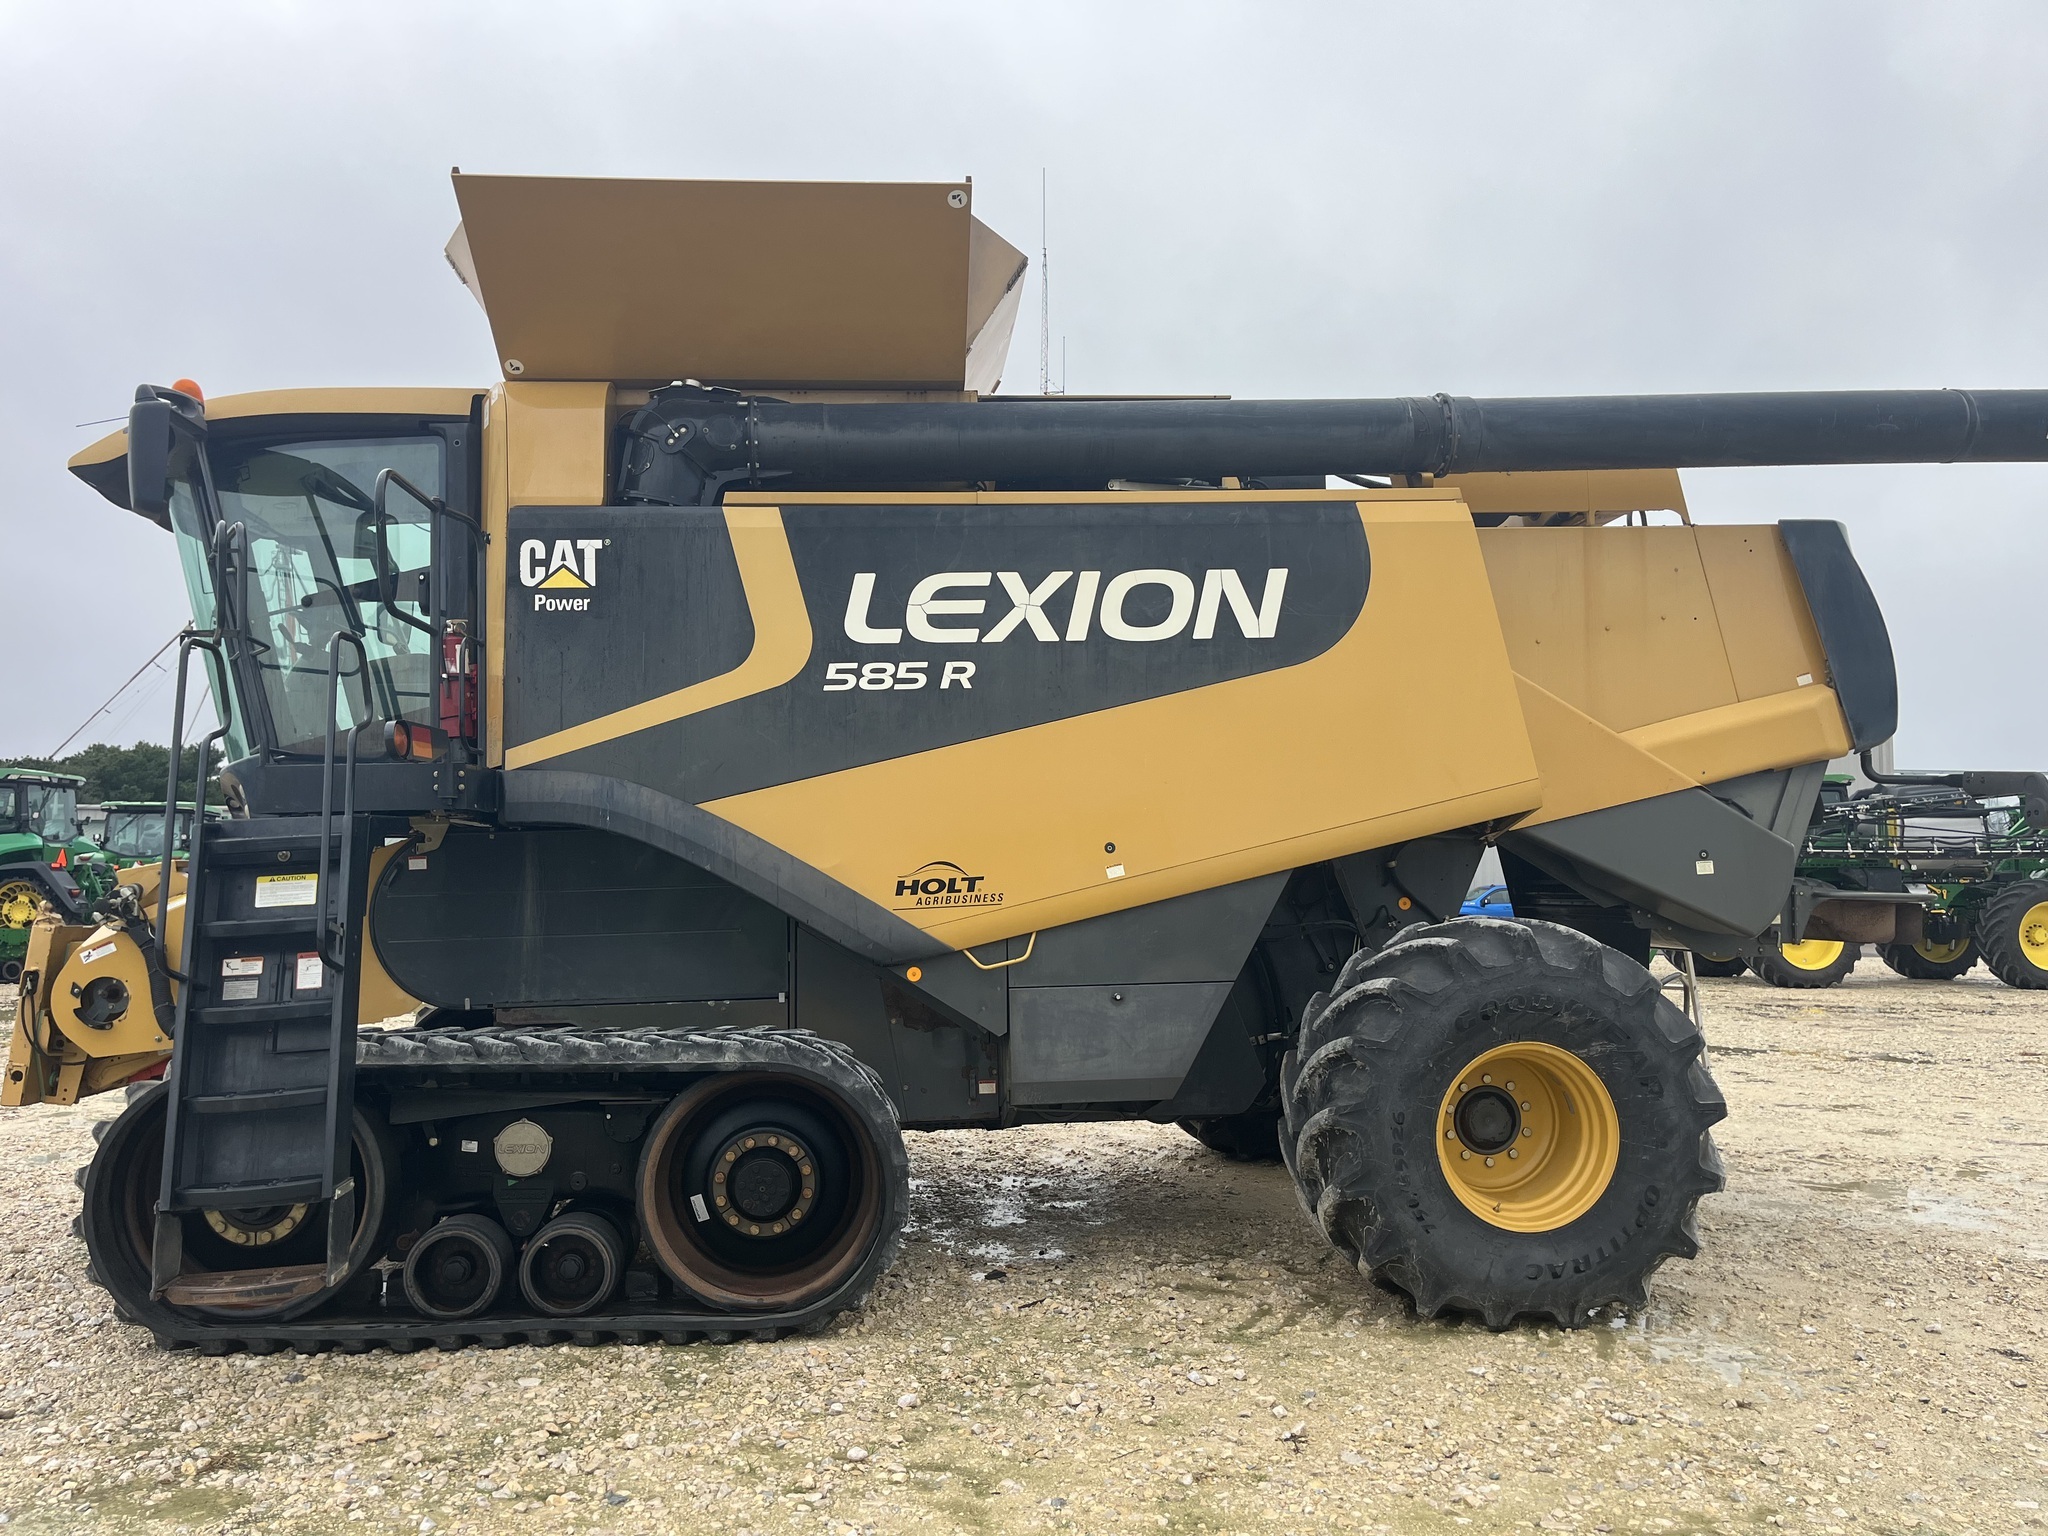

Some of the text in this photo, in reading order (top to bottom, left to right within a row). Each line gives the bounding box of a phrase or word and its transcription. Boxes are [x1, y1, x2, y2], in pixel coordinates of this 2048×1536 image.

[534, 594, 591, 612] Power
[844, 568, 1289, 644] LEXION
[822, 660, 977, 692] 585 R
[895, 875, 985, 897] HOLT
[915, 892, 1005, 906] AGRIBUSINESS
[498, 1143, 548, 1155] LEXION
[1525, 1184, 1661, 1281] OPTITRAC
